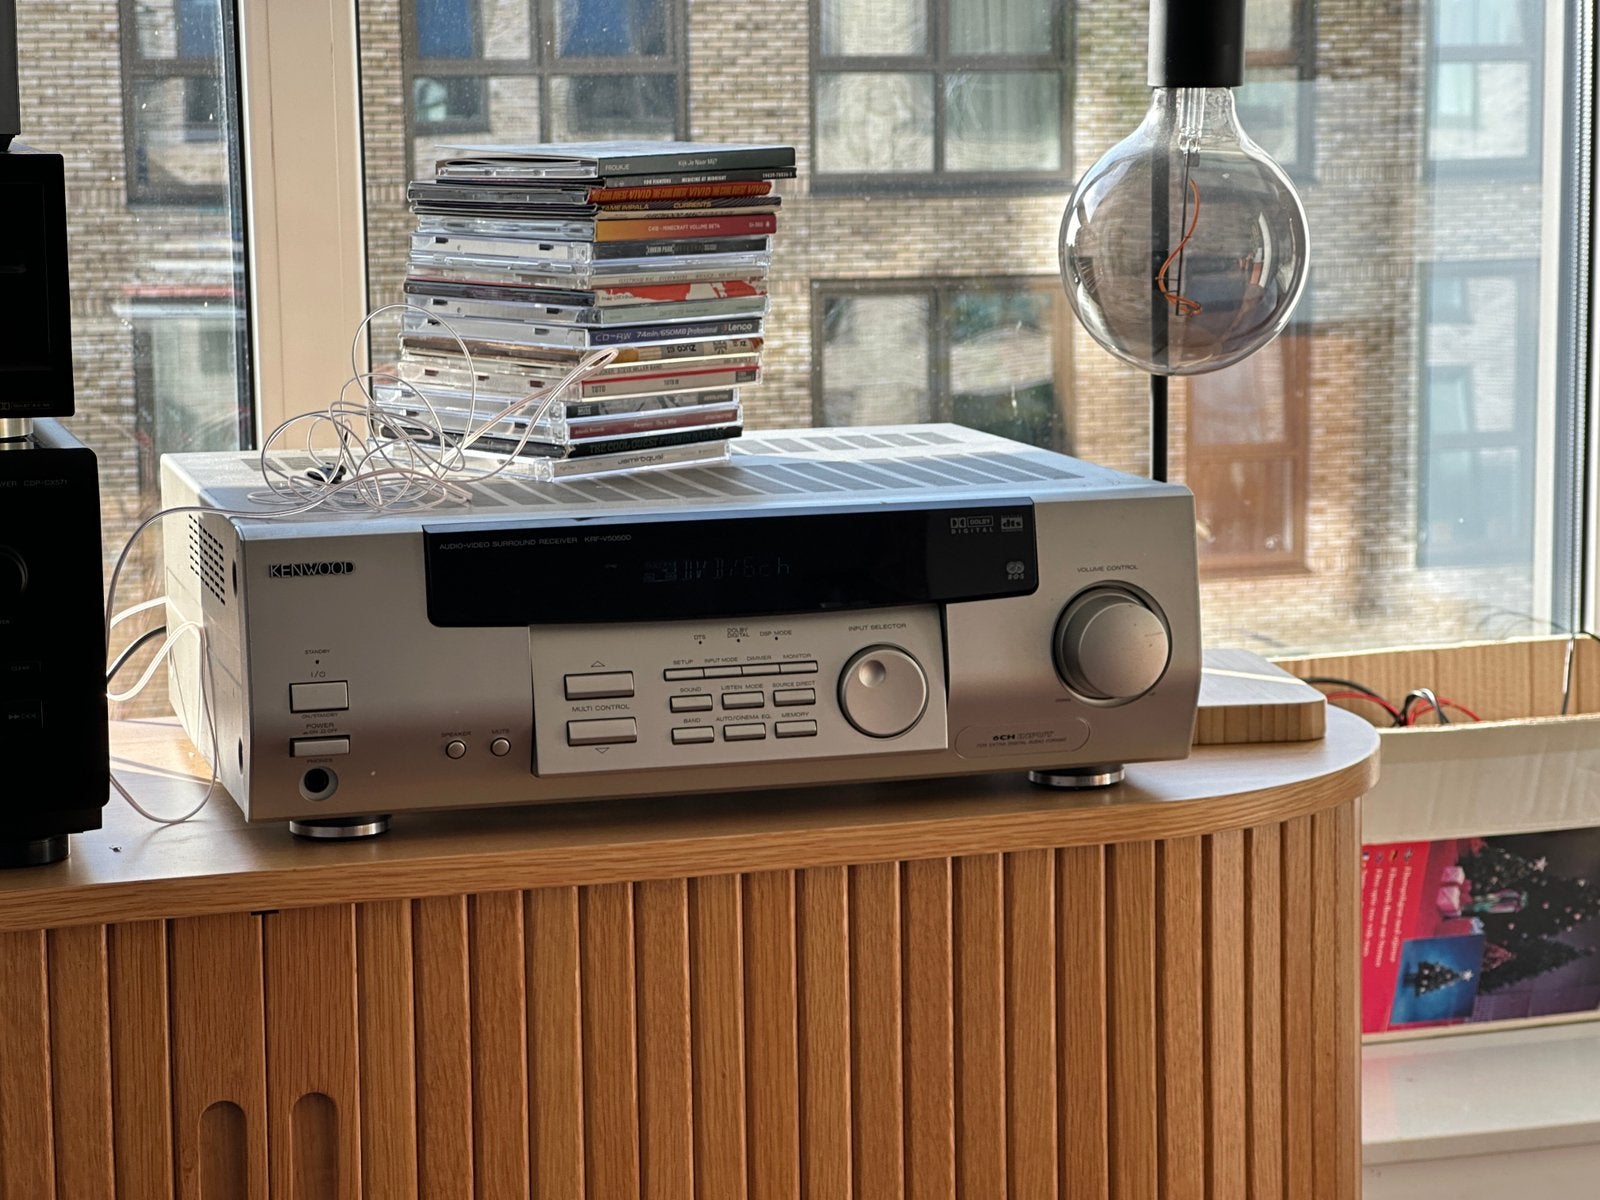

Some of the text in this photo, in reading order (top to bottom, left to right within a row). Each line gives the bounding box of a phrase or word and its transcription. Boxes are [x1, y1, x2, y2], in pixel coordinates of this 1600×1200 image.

[605, 163, 630, 171] FROUKJE
[629, 188, 652, 199] VIVID
[689, 185, 712, 196] VIVID
[747, 183, 769, 194] VIVID
[673, 201, 711, 209] CURRENTS
[595, 332, 632, 342] CD-RW
[728, 323, 753, 331] Lenco
[592, 385, 606, 393] TOTO
[589, 444, 607, 453] THE
[607, 441, 631, 452] COOL
[631, 439, 657, 450] QUEST
[439, 541, 490, 550] AUDIO-VIDEO
[492, 539, 536, 548] SURROUND
[539, 537, 578, 545] RECEIVER
[268, 561, 354, 578] KENWOOD
[848, 622, 907, 632] INPUT SELECTOR
[716, 714, 760, 722] AUTO/CINEMA
